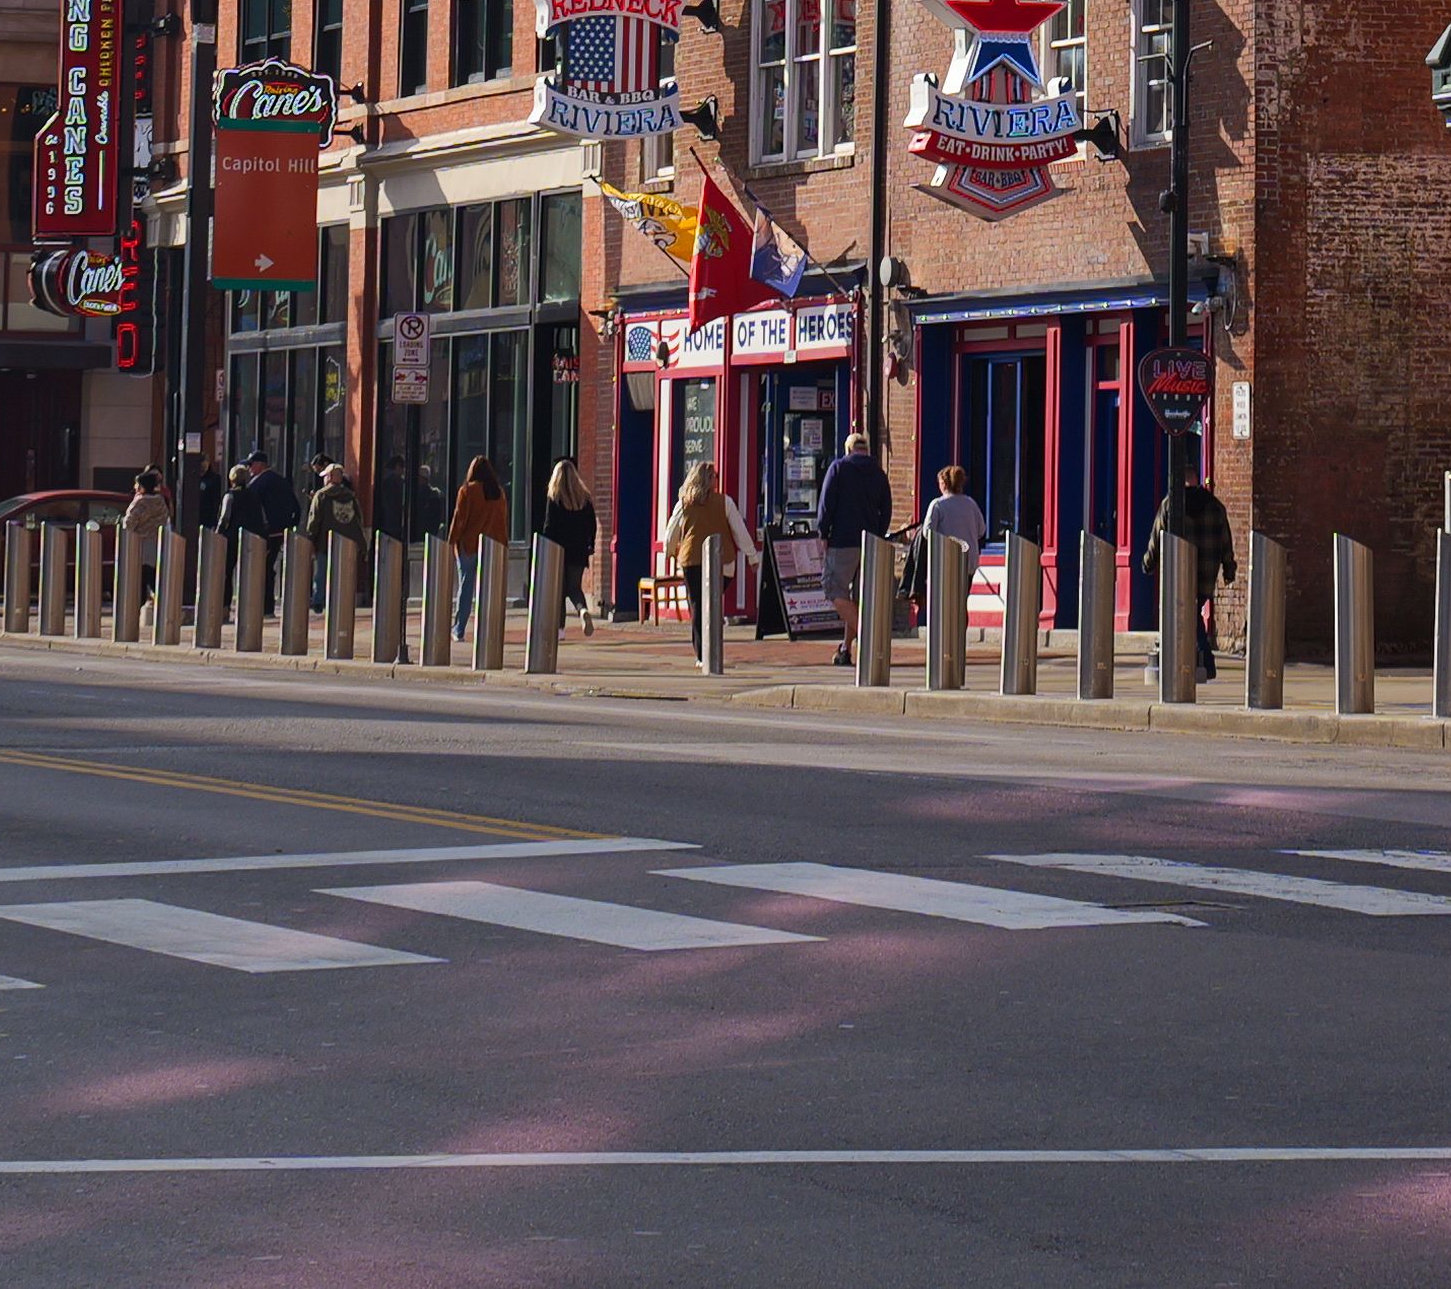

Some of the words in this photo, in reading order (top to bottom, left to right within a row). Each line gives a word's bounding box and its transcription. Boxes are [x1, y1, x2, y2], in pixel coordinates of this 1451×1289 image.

[99, 19, 114, 87] CHICKEN
[229, 78, 328, 120] Cane's
[566, 85, 601, 105] BAR
[604, 93, 616, 105] &
[619, 88, 655, 105] BBQ
[548, 96, 678, 137] RIVIERA
[932, 94, 1077, 139] RIVIERA
[63, 66, 87, 215] CANES
[222, 155, 281, 175] Capitol
[288, 158, 316, 175] Hill
[67, 249, 126, 306] Cane's
[684, 323, 724, 353] HOME
[737, 322, 757, 348] OF
[759, 319, 787, 347] THE
[798, 311, 854, 343] HEROES
[1147, 372, 1208, 394] Music
[1153, 359, 1207, 380] LIVE
